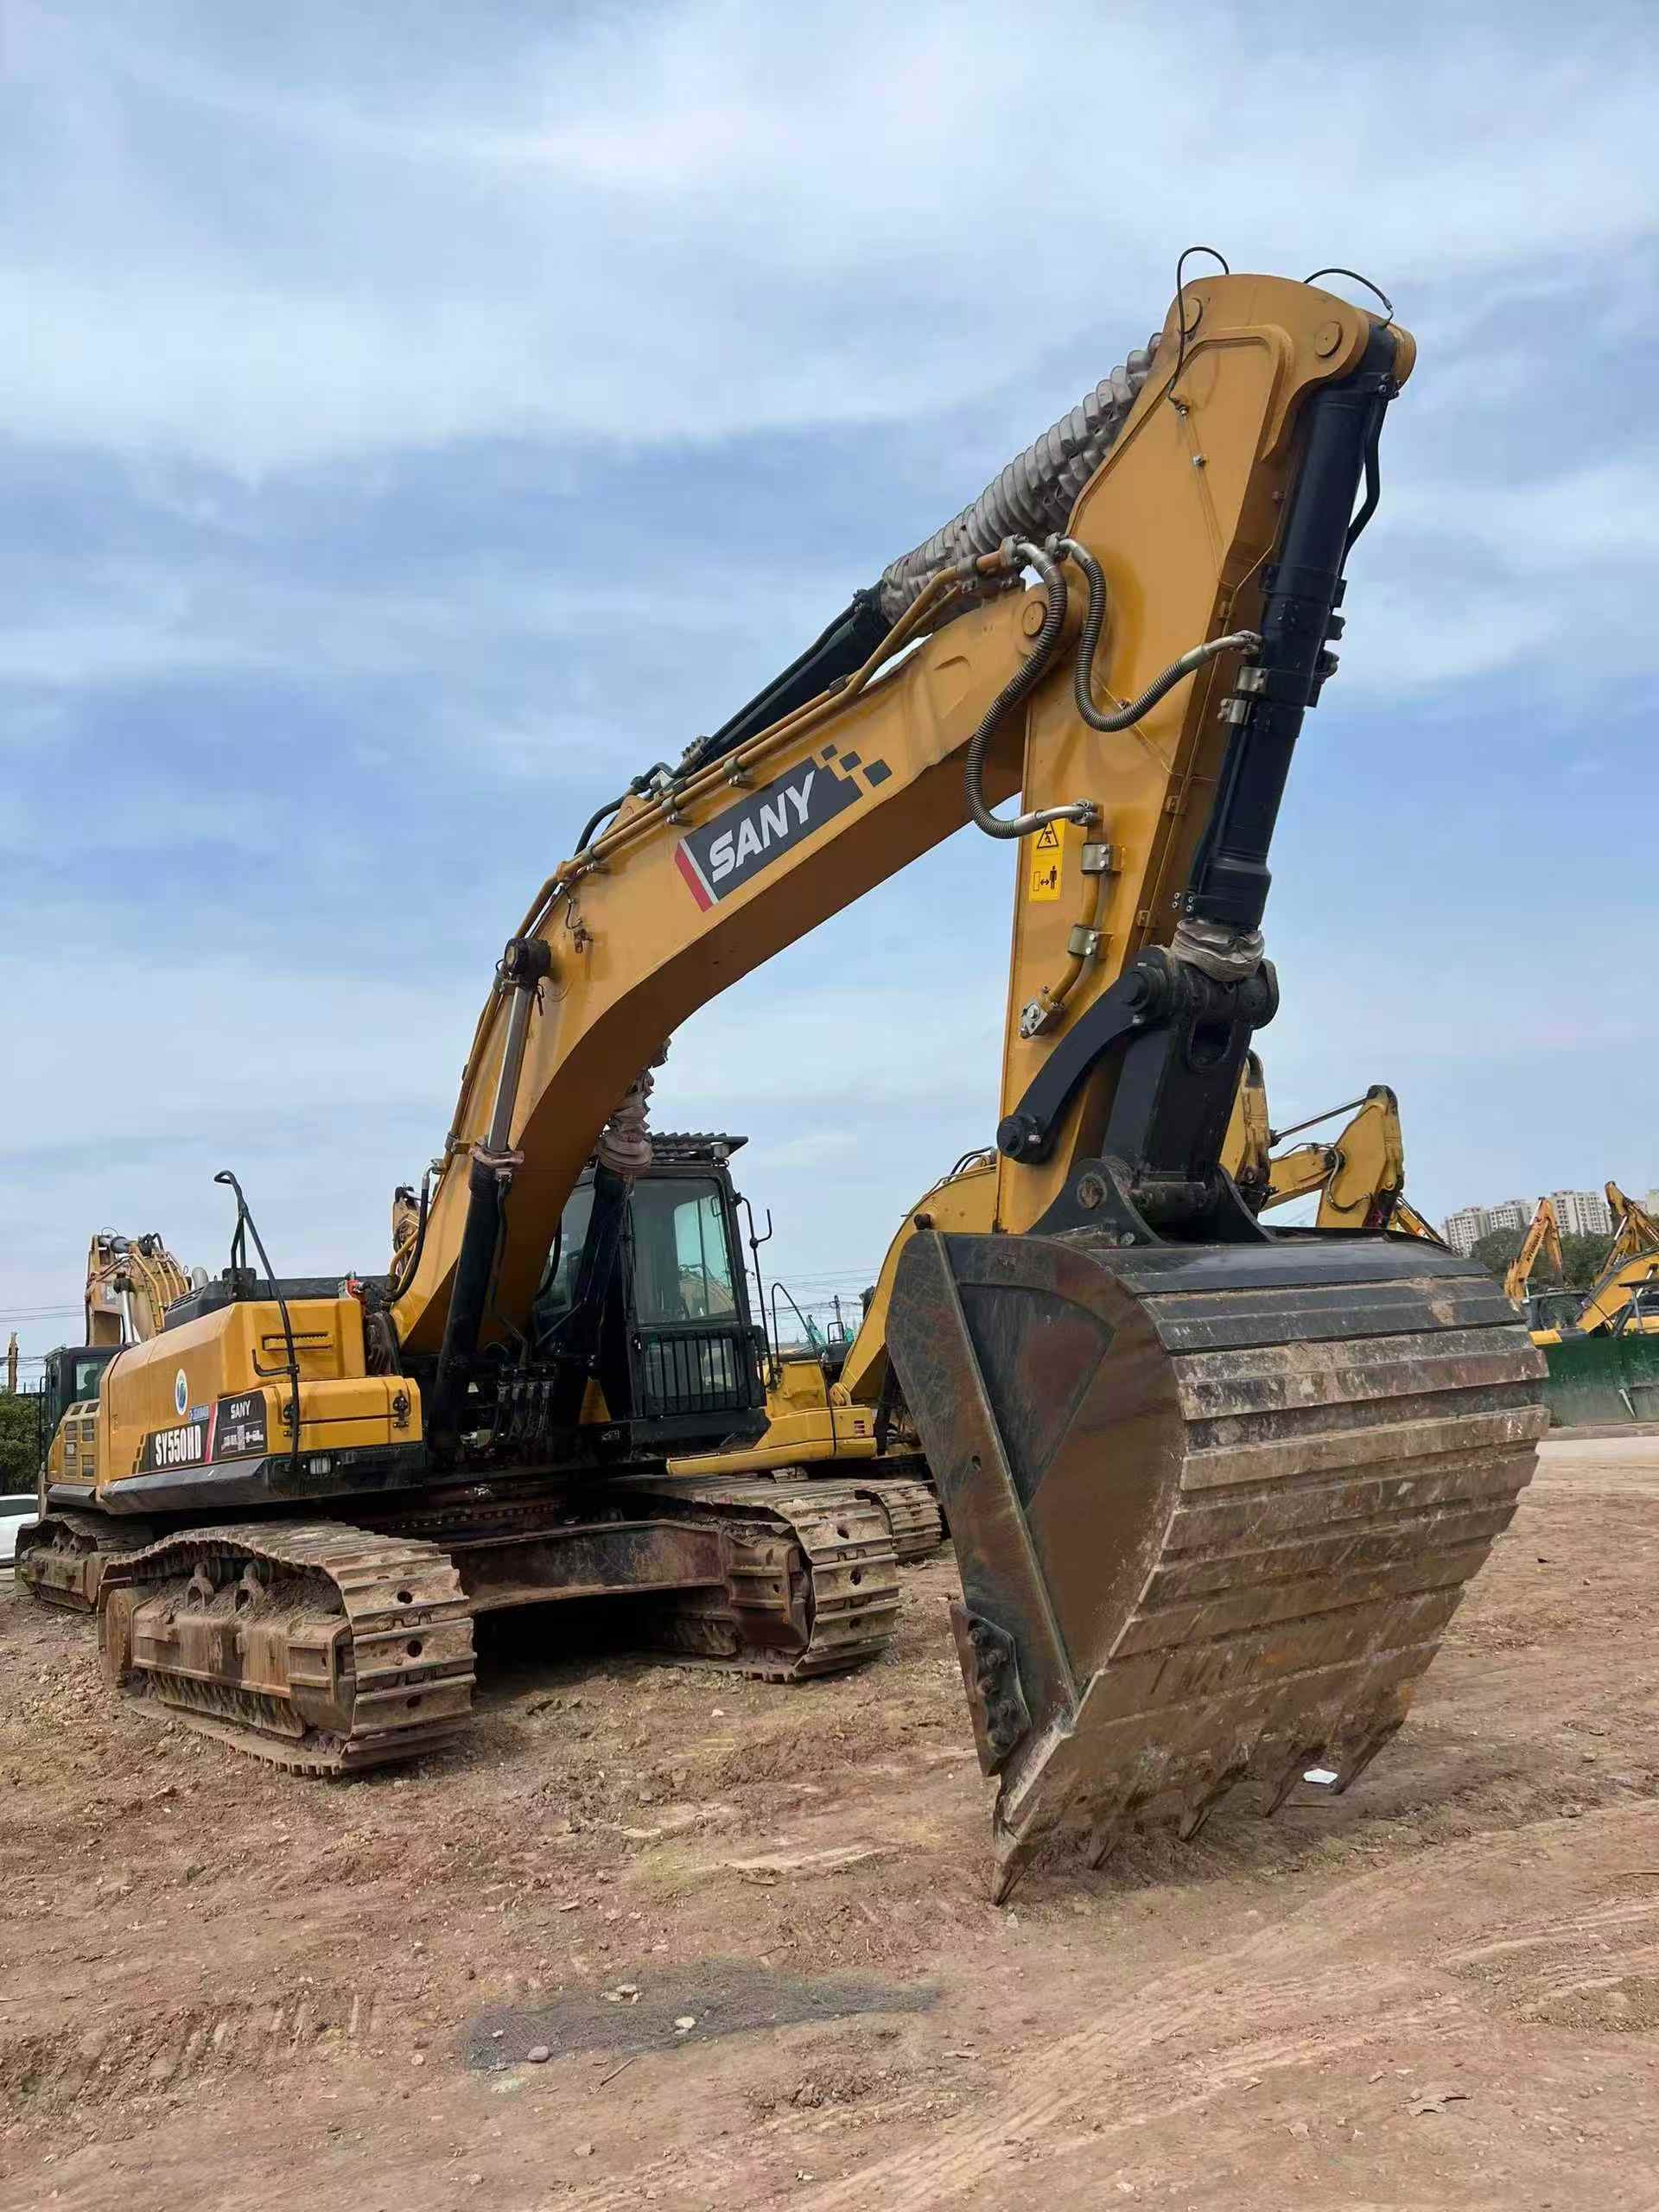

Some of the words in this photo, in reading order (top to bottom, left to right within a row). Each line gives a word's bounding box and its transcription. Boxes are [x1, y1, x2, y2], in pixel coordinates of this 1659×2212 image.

[709, 770, 815, 883] SANY
[230, 1400, 251, 1420] SANY
[155, 1425, 201, 1466] SY550HD
